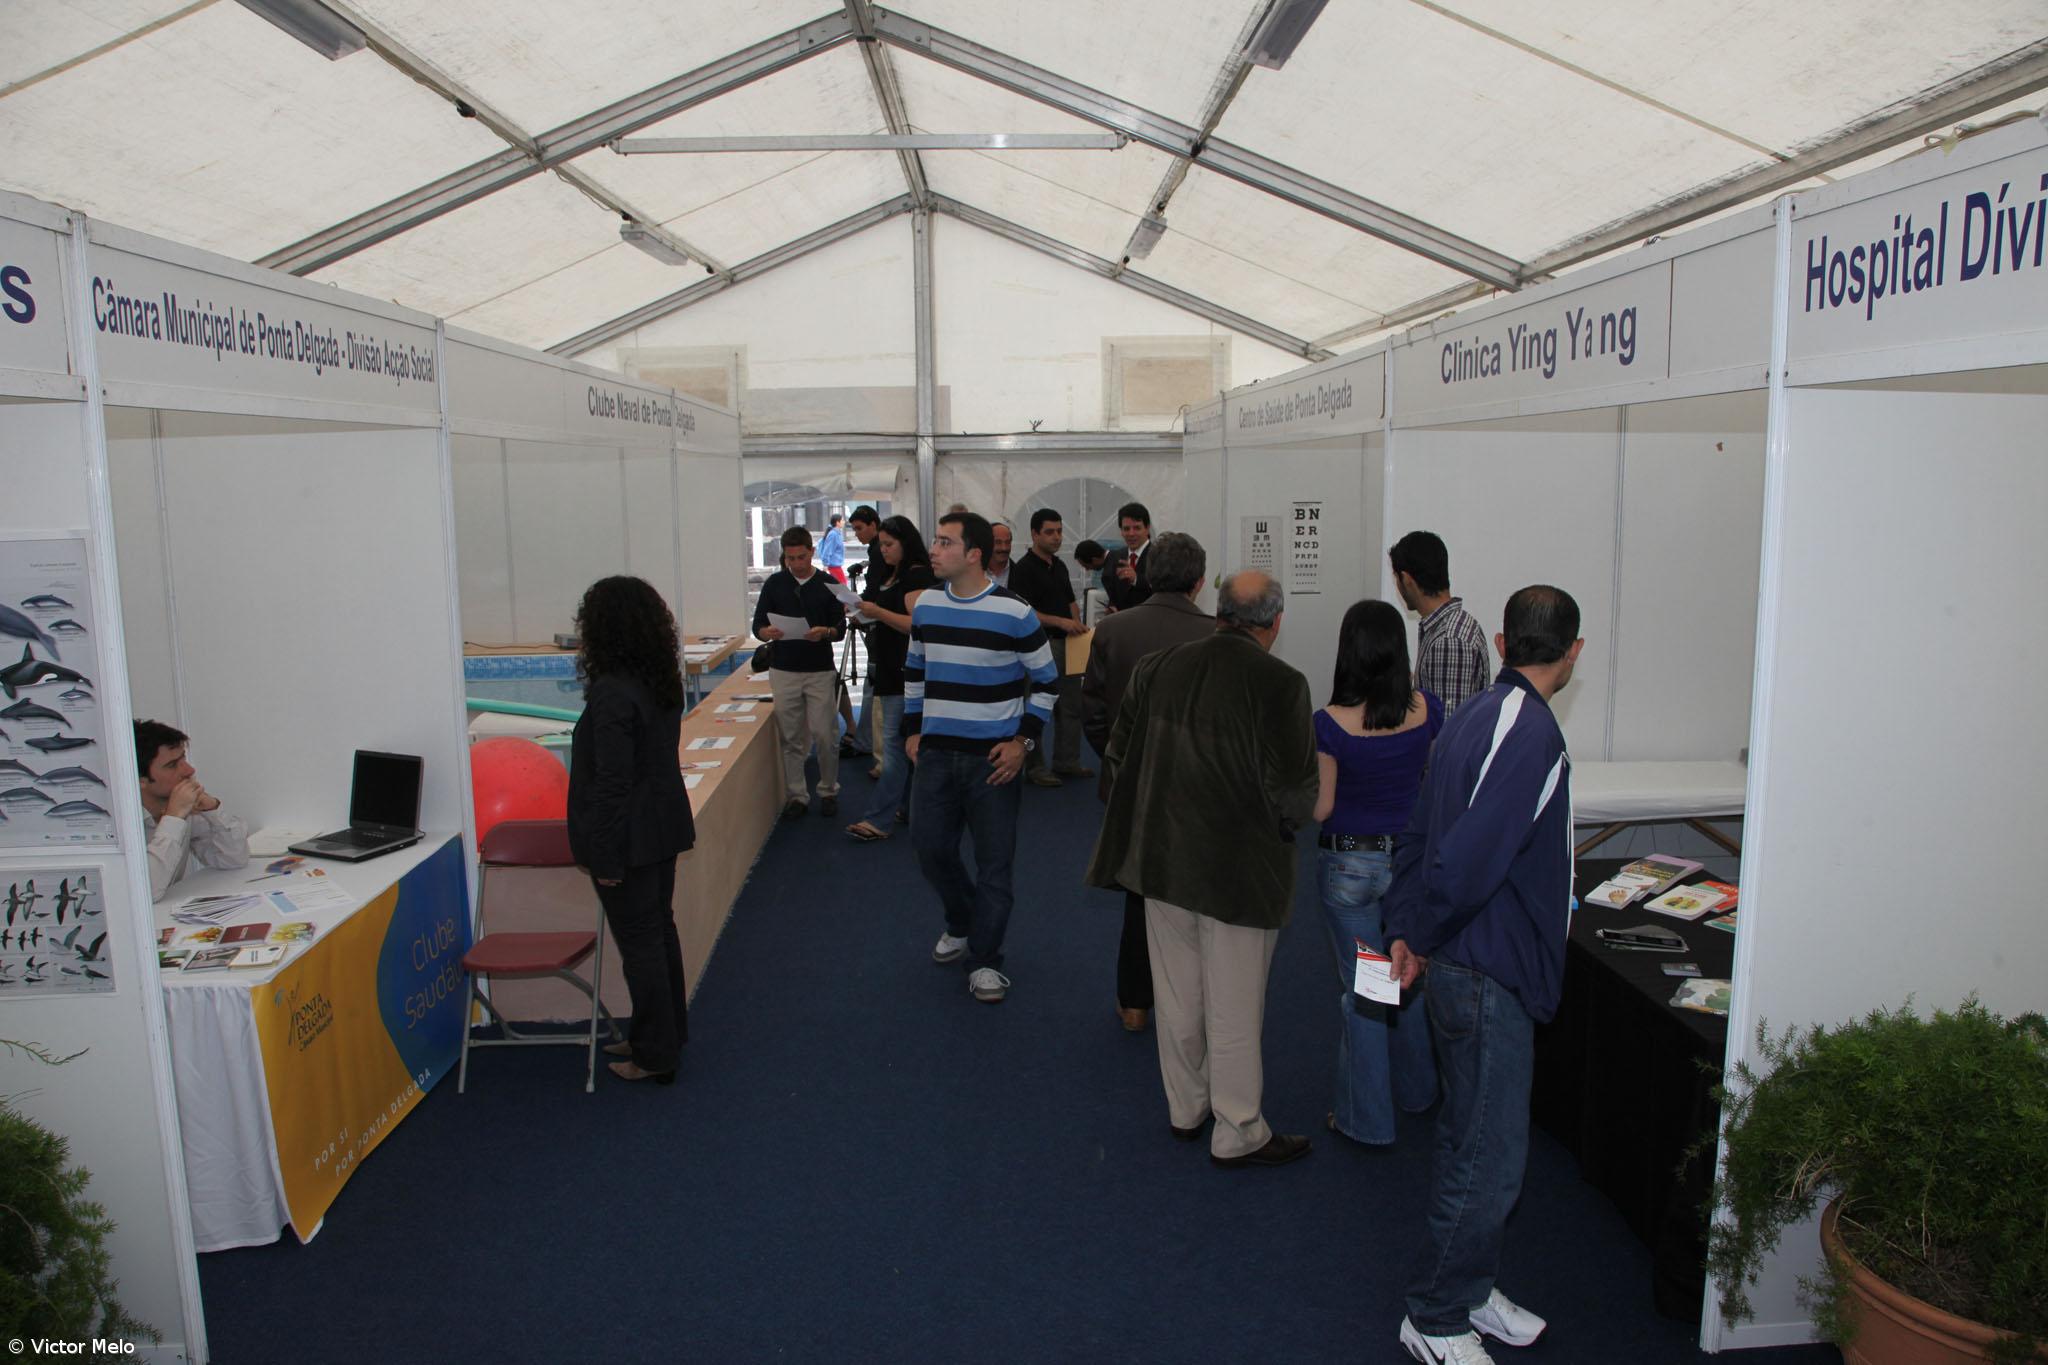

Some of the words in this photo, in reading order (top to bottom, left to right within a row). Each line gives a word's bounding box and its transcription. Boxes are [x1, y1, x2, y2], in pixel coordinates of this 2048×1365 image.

[1806, 201, 1948, 321] Hospital
[93, 276, 161, 340] Câmara
[164, 292, 236, 361] Municipal
[240, 309, 256, 355] de
[258, 312, 294, 361] Ponta
[296, 320, 340, 375] Delgada
[347, 331, 382, 374] Divisão
[384, 343, 410, 386] Acção
[411, 345, 435, 383] Social
[1441, 336, 1501, 384] Clinica
[1508, 323, 1557, 380] Ying
[1566, 306, 1637, 366] Yang
[588, 386, 615, 419] Clube
[617, 392, 640, 422] Naval
[641, 398, 651, 425] de
[652, 400, 672, 428] Ponta
[1239, 406, 1256, 429] Centro
[1257, 403, 1265, 427] de
[1285, 395, 1294, 422] de
[1295, 391, 1316, 420] Ponta
[1317, 378, 1352, 420] Delgada
[413, 918, 456, 971] Clube
[295, 993, 323, 1025] PONTA
[298, 999, 332, 1040] DELGADA
[336, 1150, 354, 1176] POR
[391, 1068, 431, 1114] DELGADA
[315, 1142, 336, 1170] POR
[339, 1127, 349, 1144] SI
